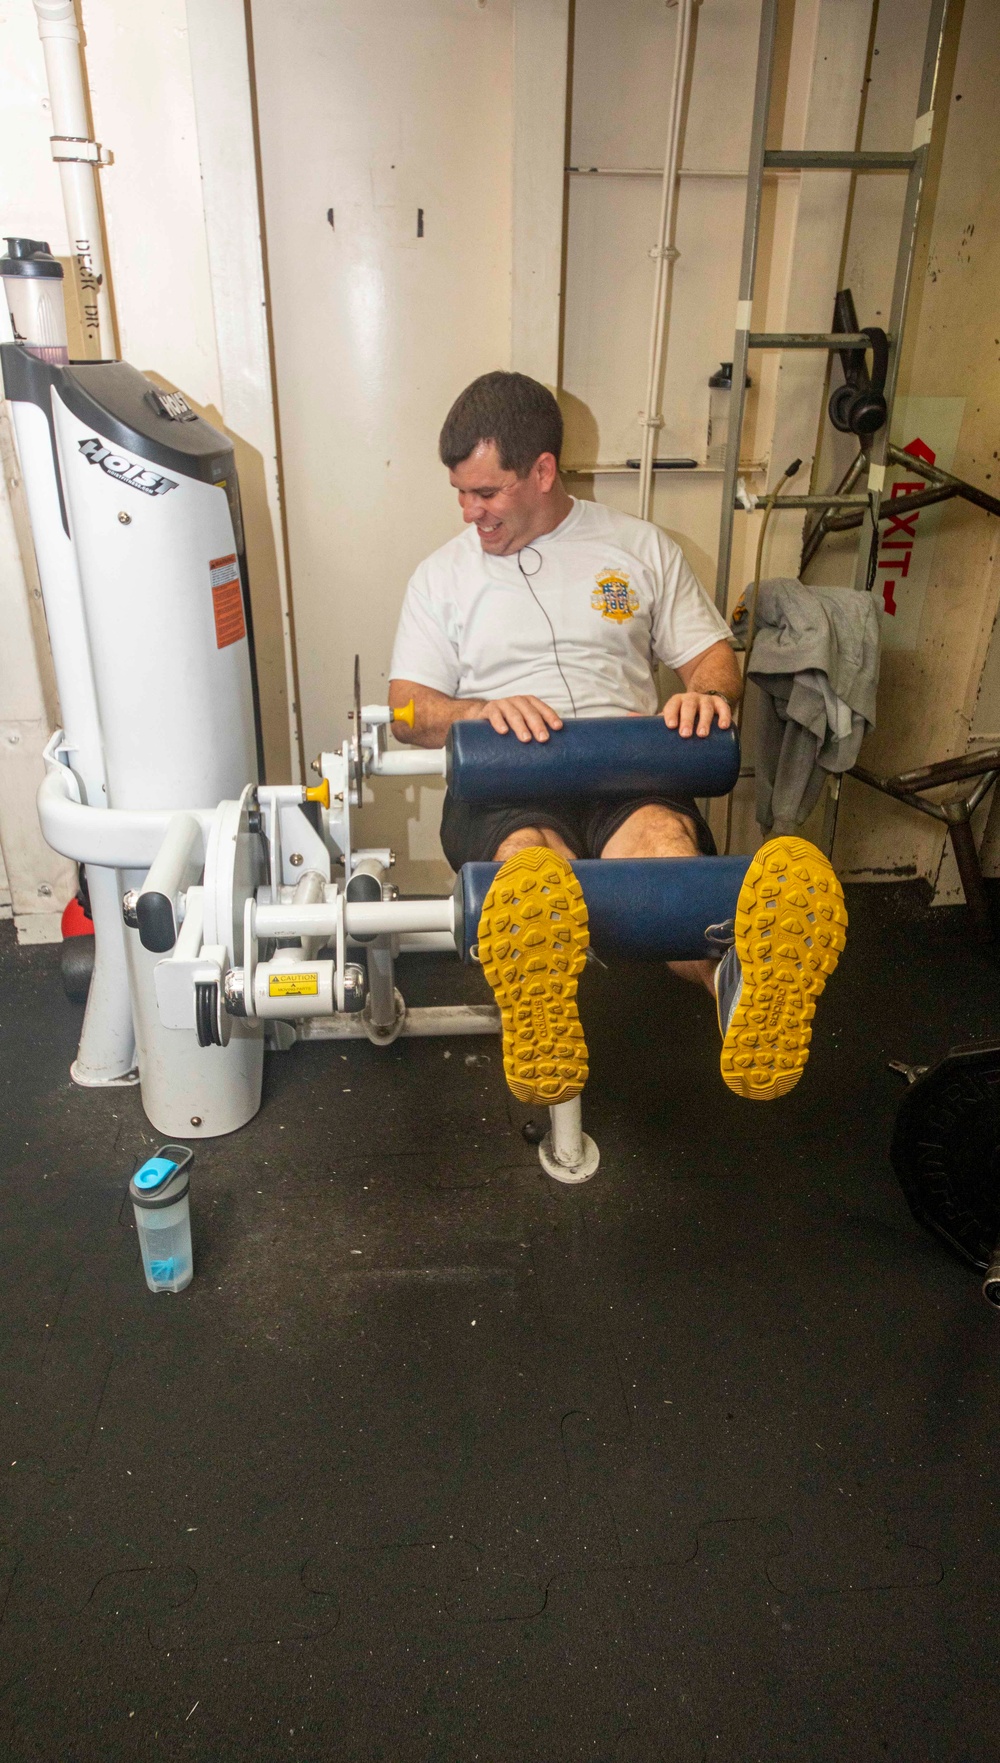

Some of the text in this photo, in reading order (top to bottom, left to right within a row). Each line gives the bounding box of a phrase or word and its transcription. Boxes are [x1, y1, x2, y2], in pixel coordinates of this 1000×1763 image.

[75, 239, 96, 290] DECK
[159, 391, 192, 417] HOIST
[79, 440, 180, 496] HOIST
[877, 482, 926, 578] EXIT
[280, 974, 316, 982] CAUTION
[533, 999, 548, 1038] adidas
[769, 988, 786, 1027] adidas
